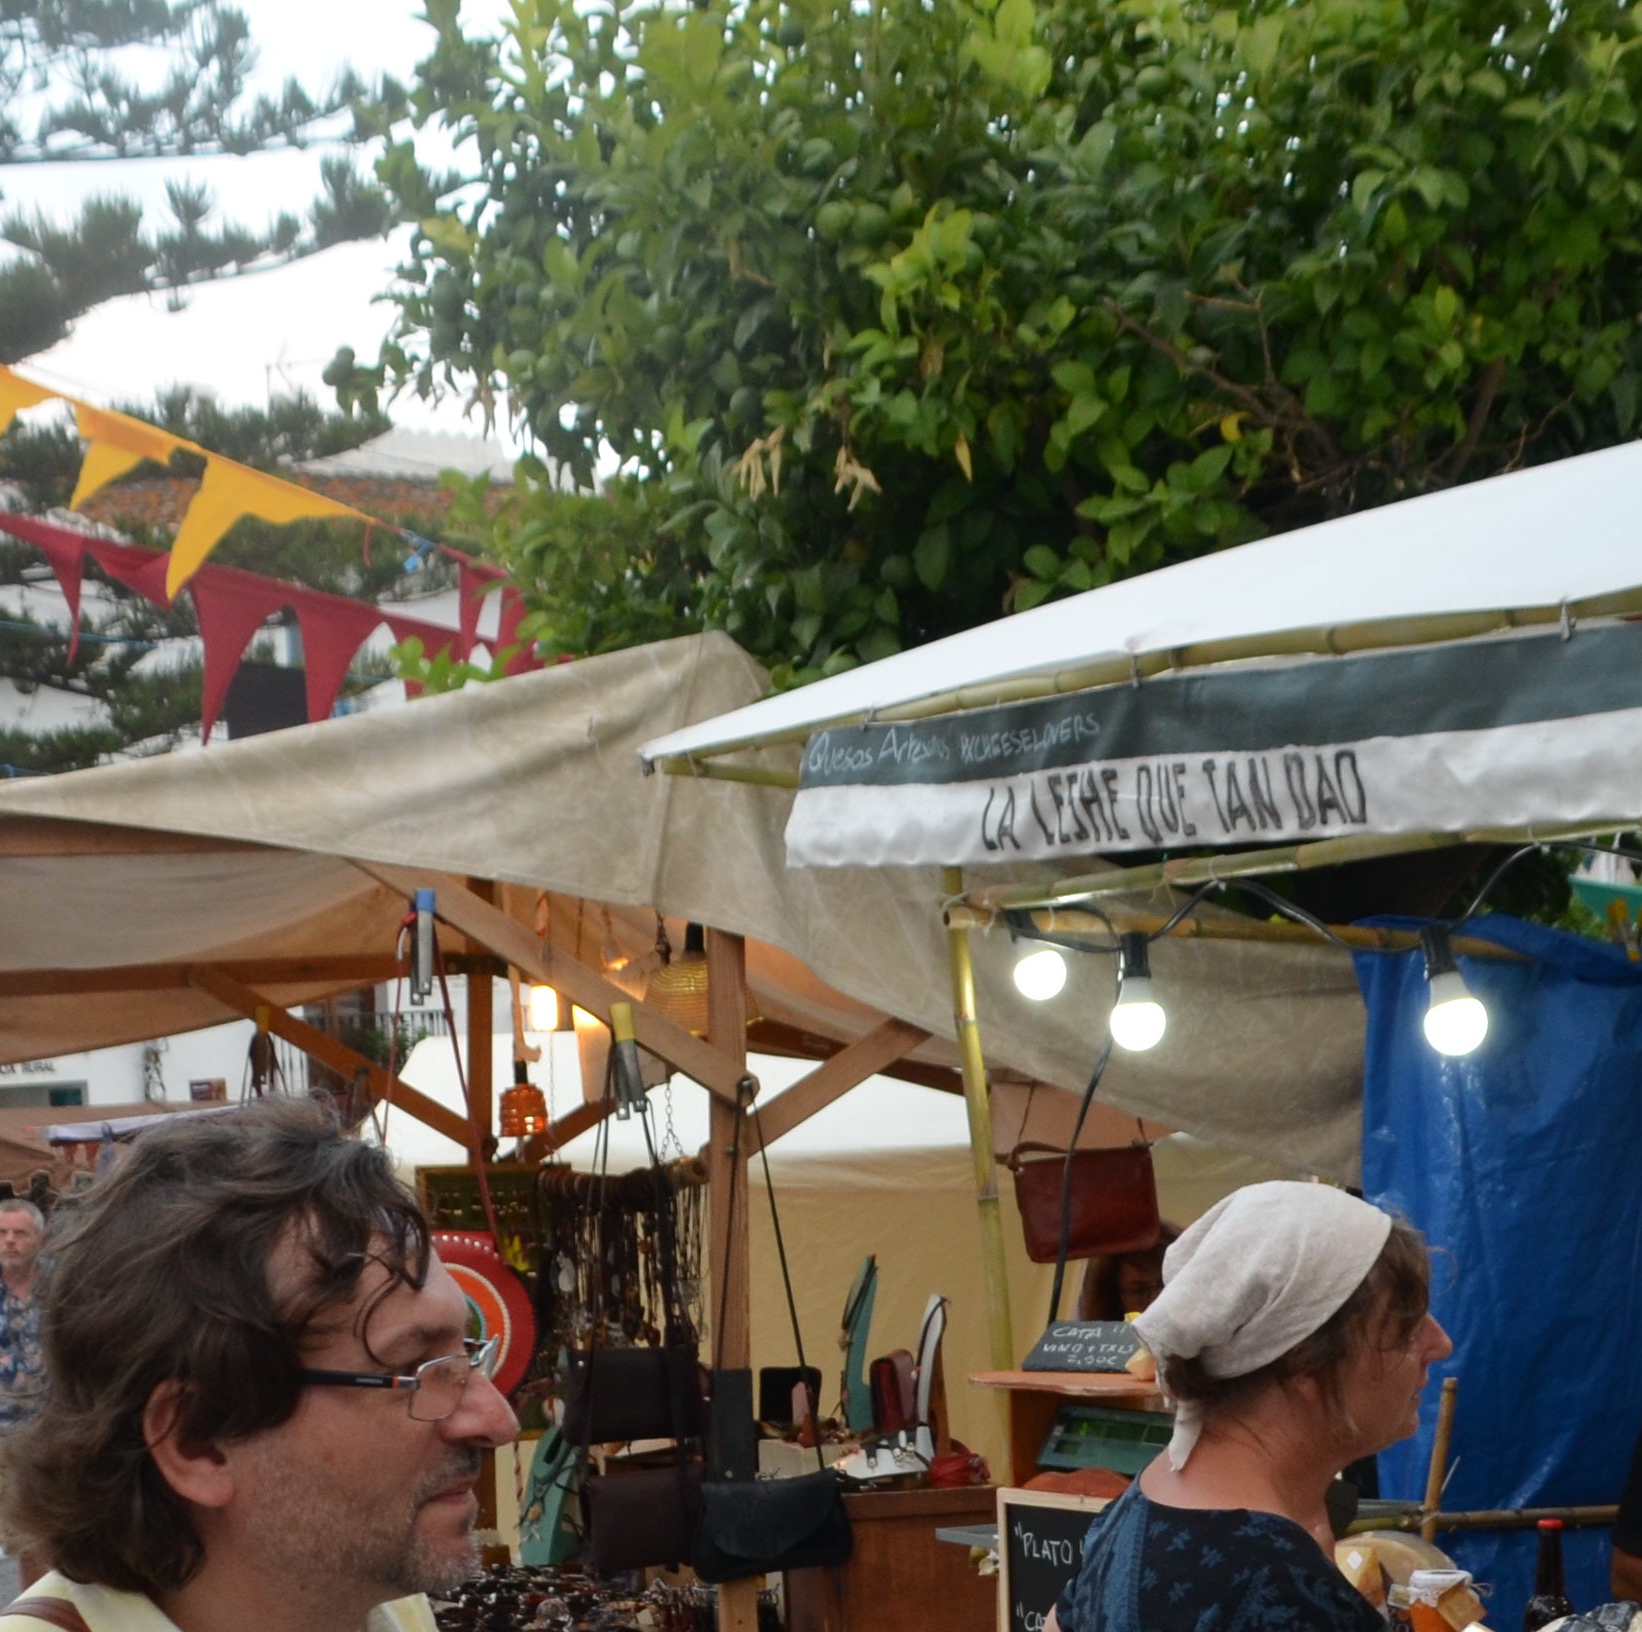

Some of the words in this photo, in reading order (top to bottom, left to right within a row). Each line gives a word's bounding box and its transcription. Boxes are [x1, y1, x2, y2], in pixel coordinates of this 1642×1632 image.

[980, 787, 1020, 850] LA
[1136, 763, 1197, 843] QUE
[1202, 757, 1282, 834] TAN
[1284, 749, 1367, 830] DAO
